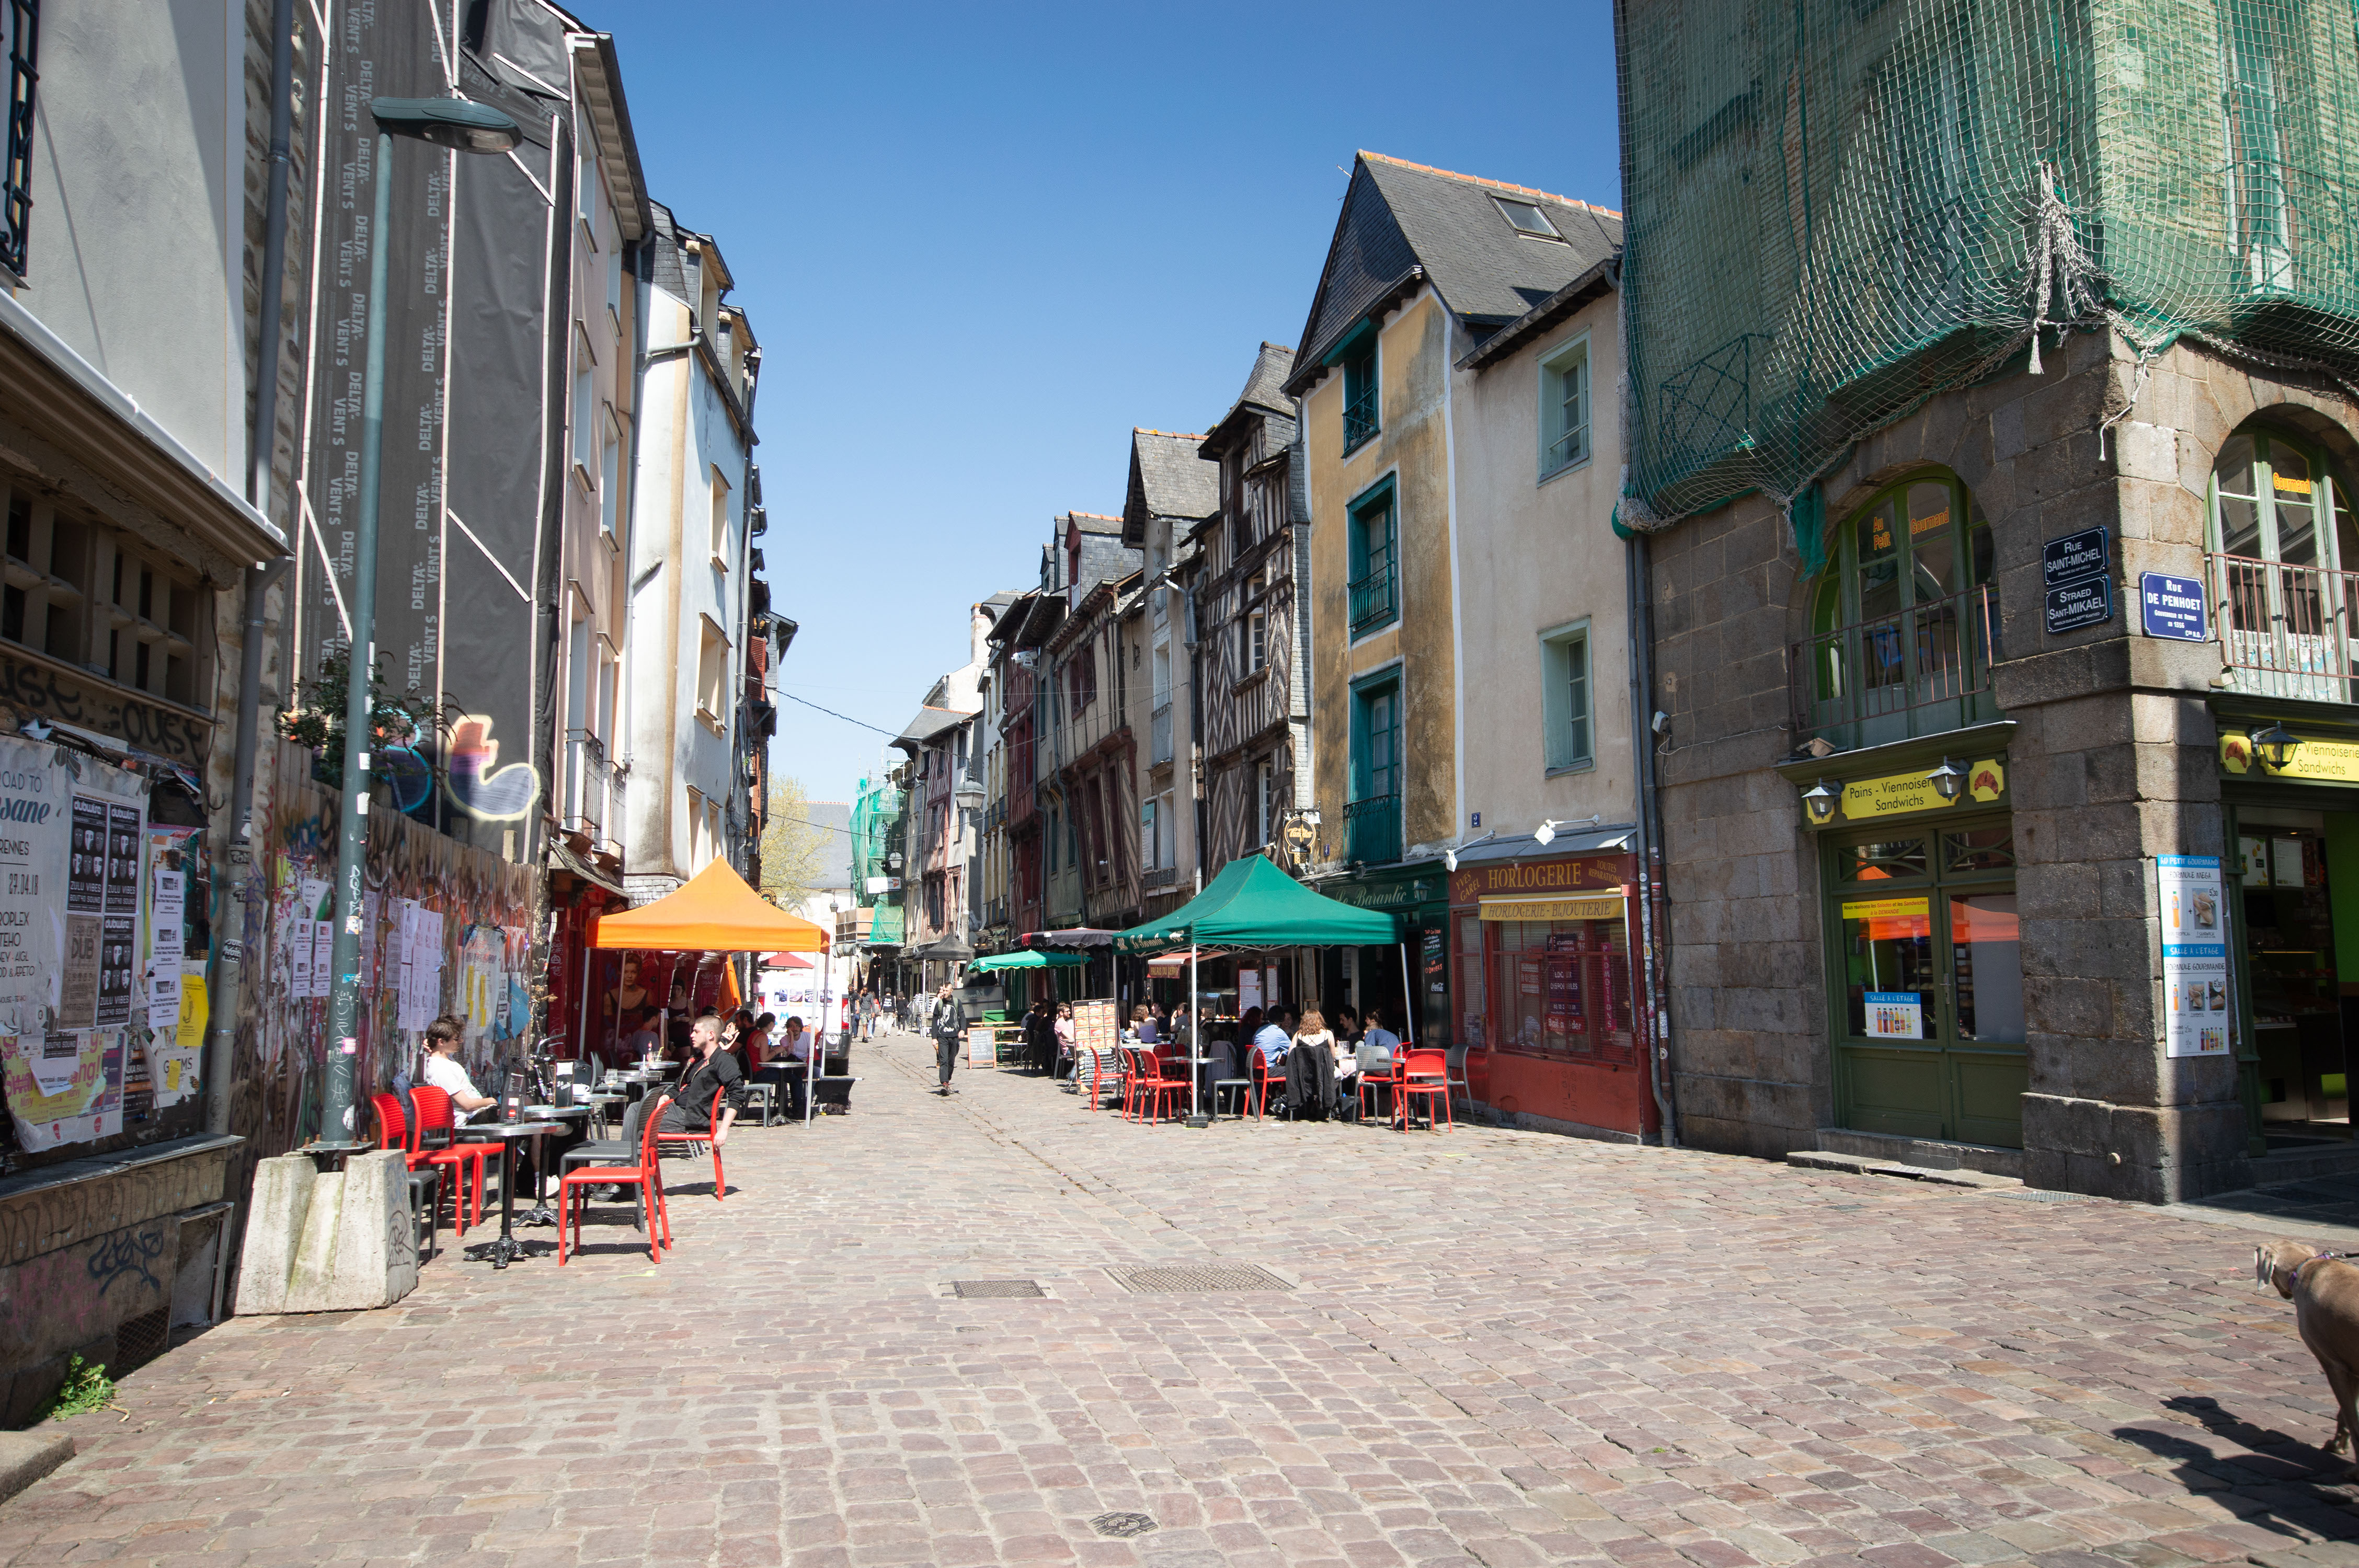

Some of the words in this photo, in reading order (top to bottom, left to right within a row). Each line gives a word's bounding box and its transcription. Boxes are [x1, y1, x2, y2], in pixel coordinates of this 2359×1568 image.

[347, 8, 360, 42] VENT
[347, 45, 359, 53] S
[346, 85, 358, 120] VENT
[345, 122, 356, 132] S
[342, 162, 356, 198] VENT
[342, 201, 354, 210] S
[340, 241, 353, 276] VENT
[339, 279, 351, 288] S
[336, 319, 350, 355] VENT
[336, 358, 348, 366] S
[333, 398, 346, 434] VENT
[332, 437, 345, 446] S
[431, 468, 442, 503] VENT
[2273, 471, 2311, 494] Gourmand
[330, 477, 343, 513] VENT
[328, 516, 341, 525] S
[1873, 516, 1883, 533] Au
[1910, 507, 1949, 535] Gourmand
[1873, 532, 1891, 550] Petit
[427, 547, 440, 583] VENT
[2047, 548, 2101, 573] SAINT-MICHEL
[2147, 592, 2159, 605] DE
[2162, 594, 2201, 610] PENHOET
[423, 627, 437, 664] VENT
[2298, 759, 2345, 775] Sandwichs
[29, 775, 42, 793] TO
[1850, 786, 1872, 799] Pains
[1875, 793, 1924, 811] Sandwichs
[1473, 814, 1478, 825] 2
[1596, 859, 1617, 873] TOUTES
[2160, 857, 2168, 865] AU
[2188, 858, 2218, 866] GOURMAND
[1456, 871, 1472, 890] YVES
[1487, 862, 1582, 889] HORLOGERIE
[1588, 868, 1622, 886] REPARATIONS
[1355, 884, 1406, 907] Barantic
[1460, 878, 1481, 901] GAREL
[1488, 904, 1546, 918] HORLOGERIE
[1551, 901, 1611, 917] BIJOUTERIE
[2171, 947, 2188, 955] SALLE
[2196, 947, 2219, 955] L'ETAGE
[1151, 966, 1161, 975] PALAIS
